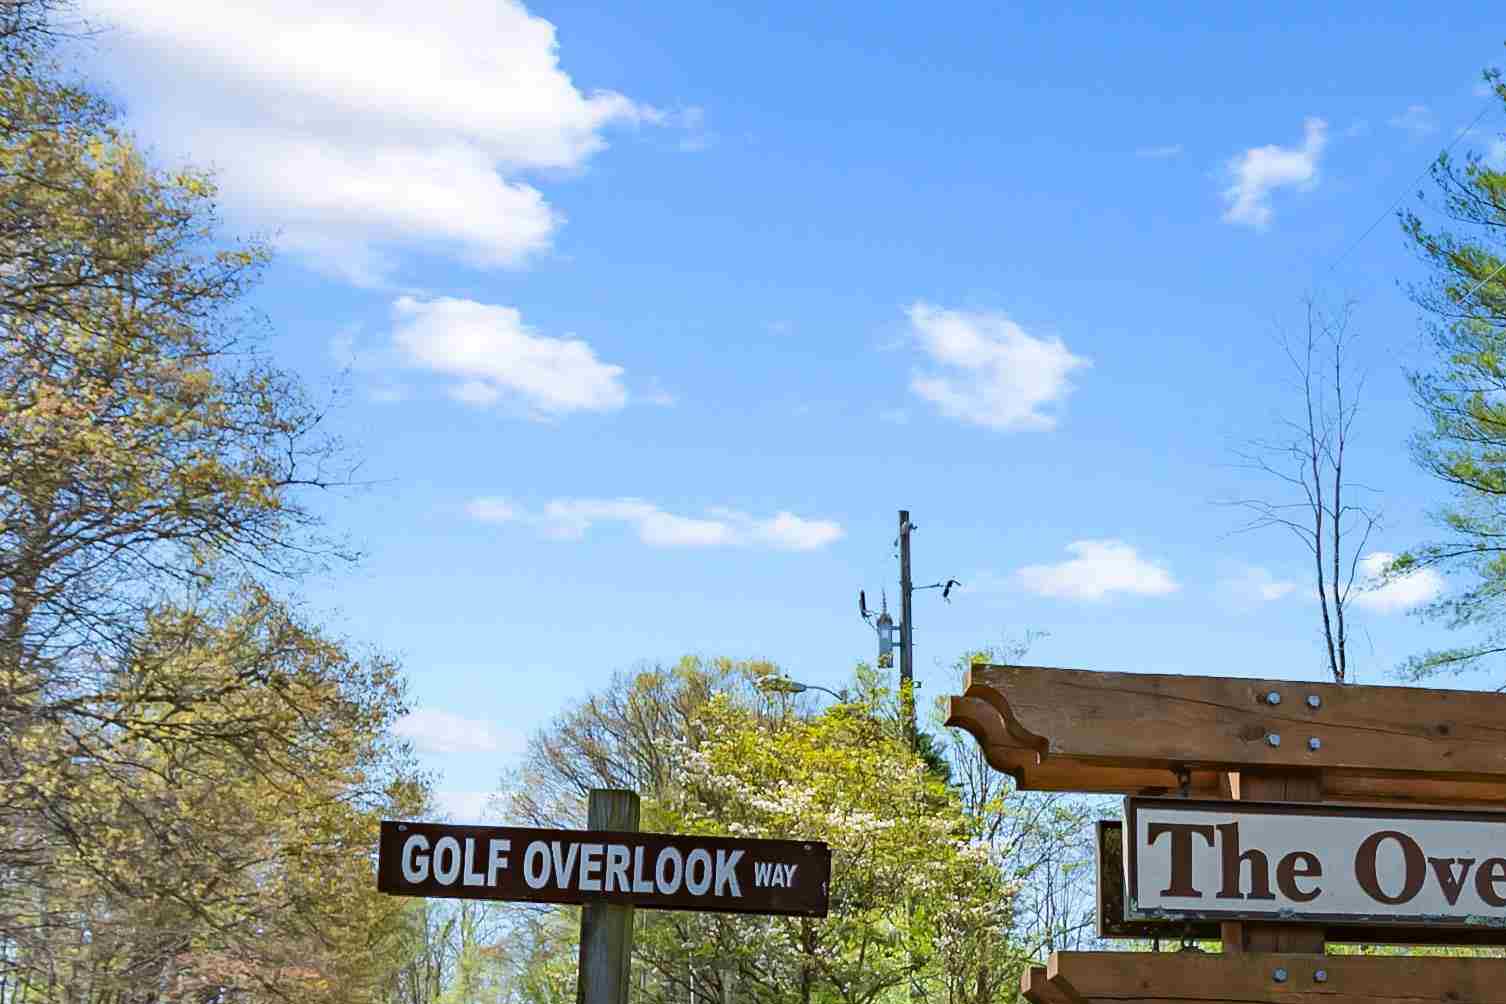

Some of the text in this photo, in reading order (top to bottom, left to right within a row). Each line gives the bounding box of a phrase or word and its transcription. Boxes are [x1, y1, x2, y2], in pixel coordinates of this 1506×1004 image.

[401, 834, 797, 897] GOLF OVERLOOK WAY
[1147, 821, 1323, 902] The
